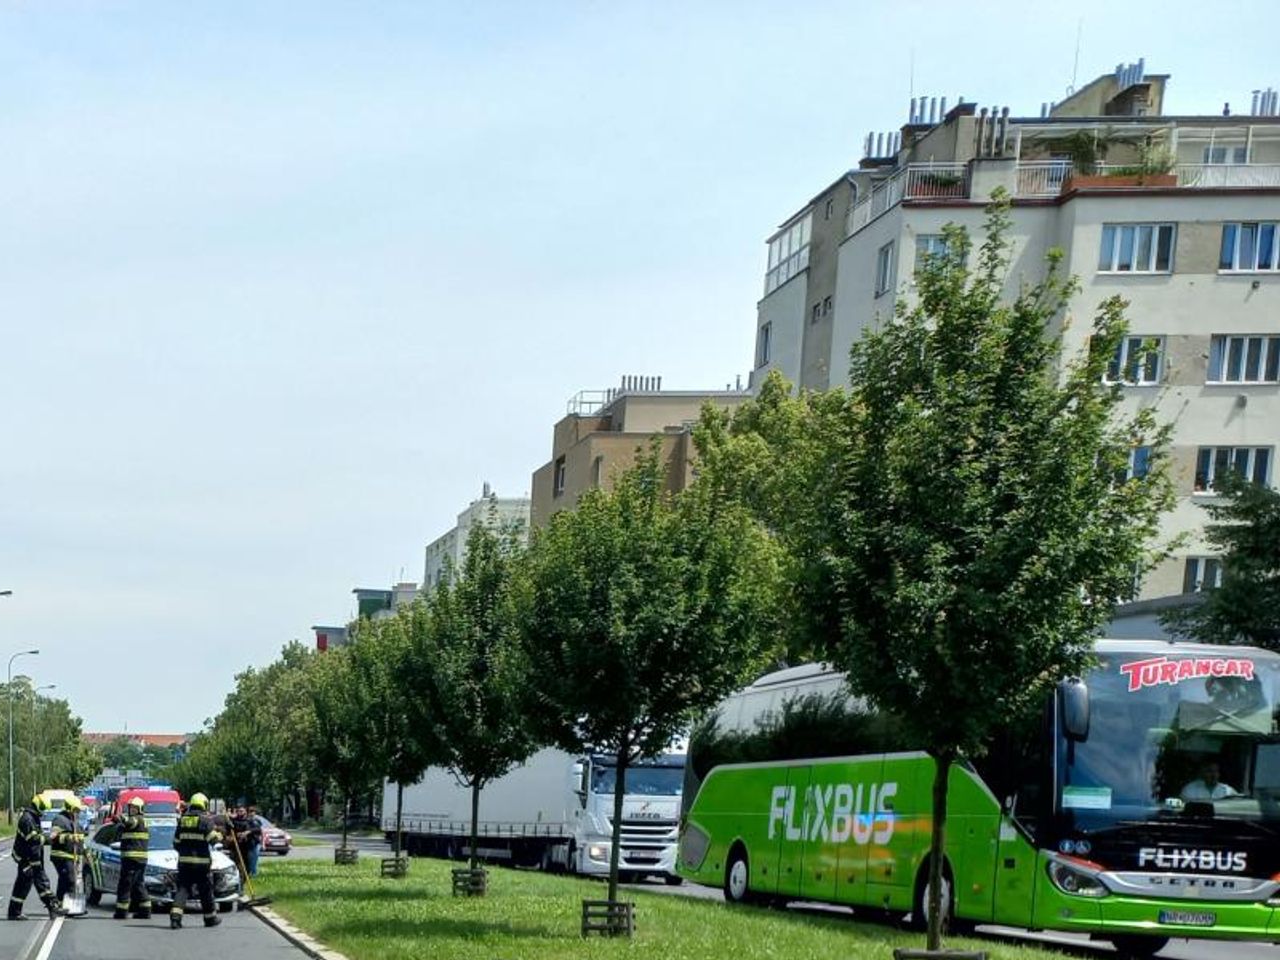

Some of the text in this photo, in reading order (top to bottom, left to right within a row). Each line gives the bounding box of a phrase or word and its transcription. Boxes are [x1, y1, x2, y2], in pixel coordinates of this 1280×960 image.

[1121, 656, 1254, 692] TURANCAR
[768, 781, 898, 845] FLIXBUS
[1138, 847, 1248, 871] FLIXBUS
